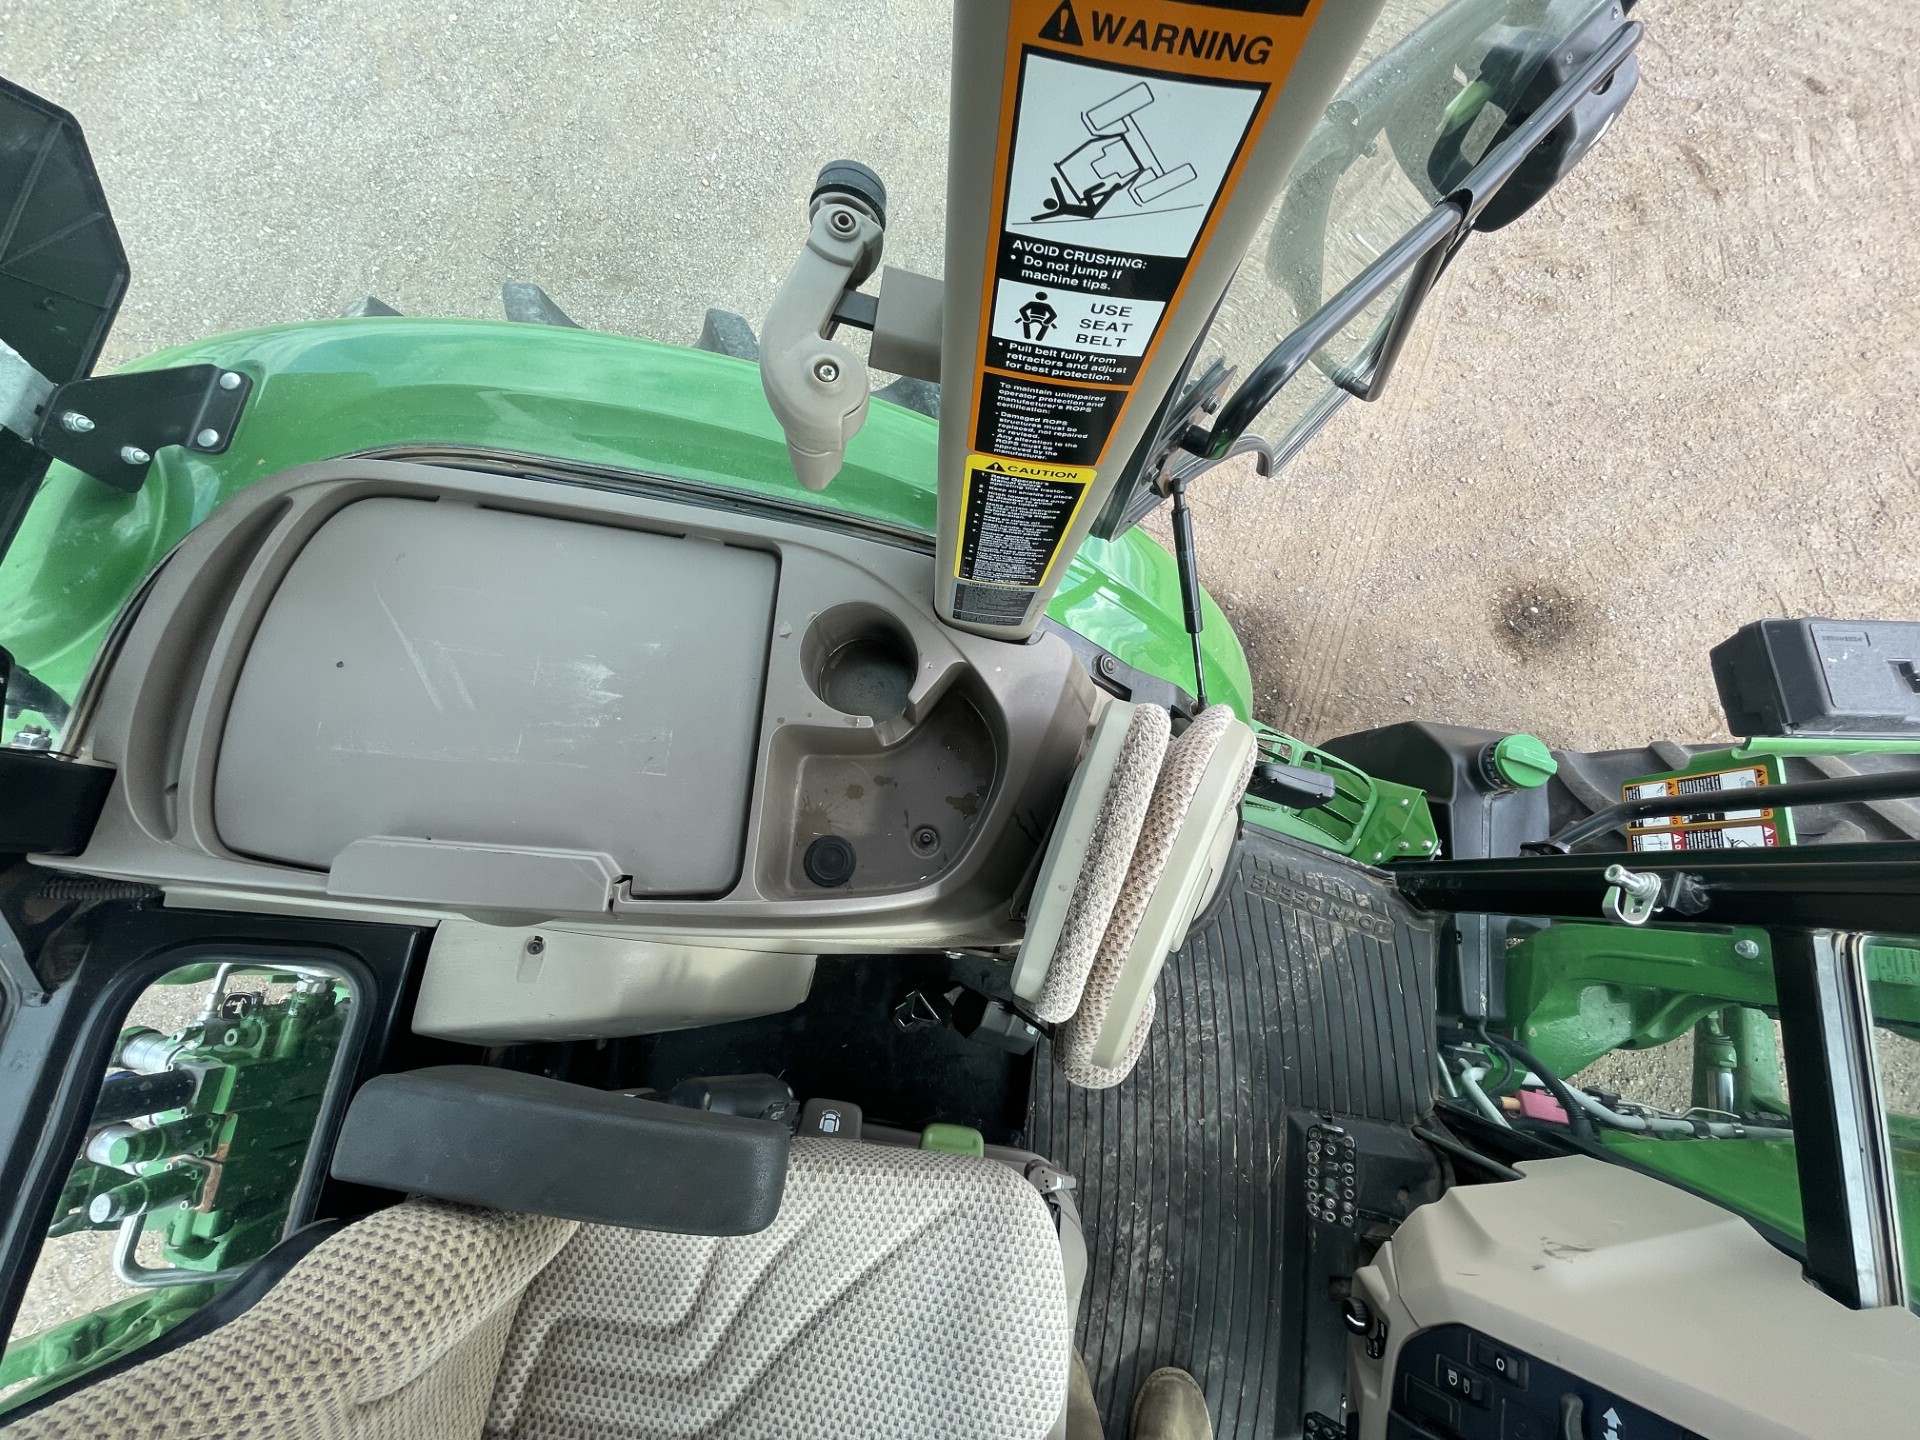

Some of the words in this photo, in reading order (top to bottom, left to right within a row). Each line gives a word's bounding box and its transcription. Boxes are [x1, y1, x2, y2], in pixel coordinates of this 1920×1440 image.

[1092, 10, 1273, 65] WARNING
[1012, 240, 1059, 257] AVOID
[1063, 249, 1147, 269] CRUSHING:
[1023, 255, 1043, 267] Do
[1046, 260, 1070, 272] not
[1072, 264, 1108, 279] jump
[1112, 269, 1123, 279] if
[1021, 268, 1078, 286] machine
[1082, 279, 1111, 290] tips.
[1090, 303, 1133, 317] USE
[1079, 318, 1133, 333] SEAT
[1075, 334, 1127, 348] BELT
[1009, 342, 1032, 353] Pull
[1035, 346, 1057, 358] belt
[1060, 350, 1086, 362] fully
[1089, 354, 1117, 364] from
[1005, 360, 1021, 369] for
[1024, 363, 1049, 373] best
[1052, 368, 1112, 381] protection.
[1007, 352, 1063, 367] retractors
[1066, 361, 1088, 370] and
[1091, 364, 1127, 374] adjust
[999, 389, 1036, 400] operator
[1038, 395, 1084, 406] protection
[1014, 385, 1052, 396] maintain
[1055, 391, 1106, 402] unimpaired
[998, 395, 1064, 409] manufacturer's
[1066, 405, 1092, 413] ROPS
[1000, 418, 1042, 428] structures
[1001, 412, 1040, 423] Damaged
[1042, 418, 1068, 426] ROPS
[1015, 437, 1052, 446] alteration
[1054, 431, 1088, 439] repaired
[1008, 465, 1078, 479] CAUTION
[1252, 874, 1325, 916] DEERE
[1328, 901, 1392, 936] JOHN
